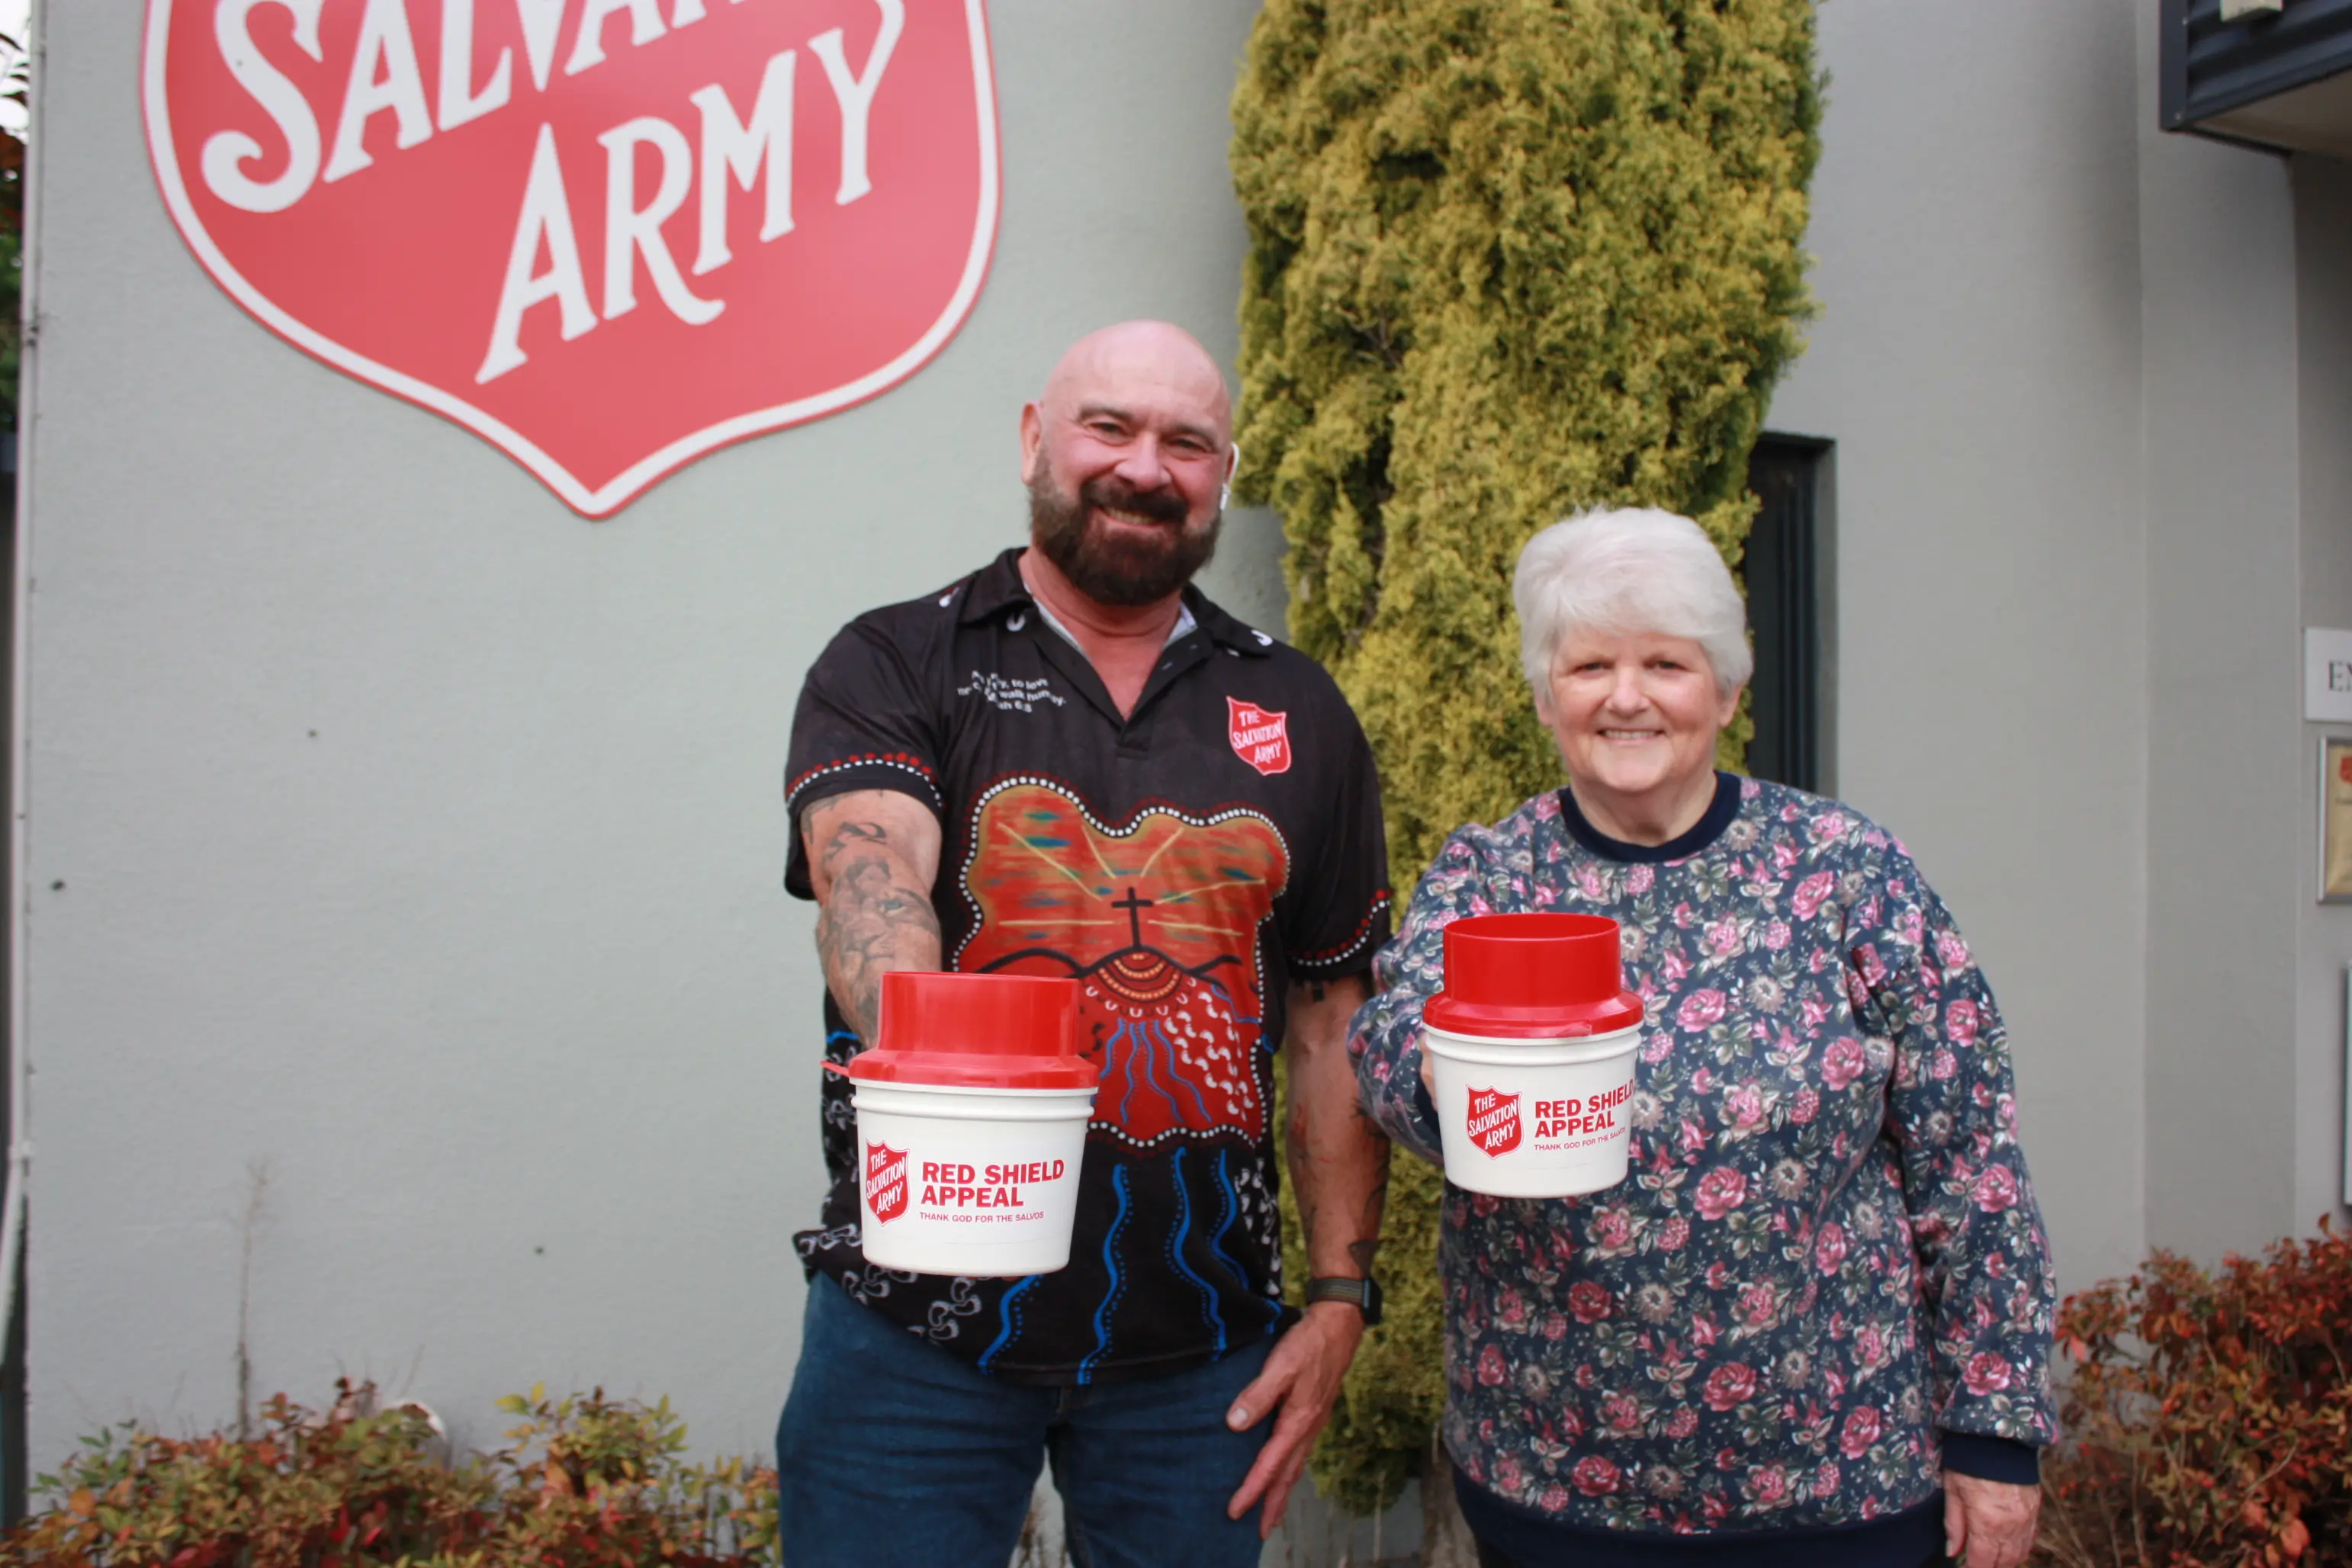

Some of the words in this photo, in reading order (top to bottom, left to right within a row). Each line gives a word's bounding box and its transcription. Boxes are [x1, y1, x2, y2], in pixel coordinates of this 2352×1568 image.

[474, 0, 904, 385] ARMY
[1238, 711, 1260, 727] THE
[1255, 741, 1281, 764] ARMY
[1474, 1093, 1496, 1113] THE
[1535, 1099, 1582, 1118] RED
[1469, 1099, 1518, 1137] SALVATION
[1534, 1110, 1615, 1138] APPEAL
[1485, 1120, 1515, 1150] ARMY
[1563, 1141, 1580, 1149] GOD
[1582, 1139, 1596, 1147] FOR
[1598, 1134, 1609, 1142] THE
[870, 1149, 887, 1172] THE
[922, 1162, 975, 1184] RED
[984, 1159, 1065, 1185] SHIELD
[866, 1156, 905, 1200] SALVATION
[876, 1181, 903, 1214] ARMY
[921, 1185, 1024, 1207] APPEAL
[919, 1212, 949, 1222] THANK
[1016, 1211, 1045, 1222] SALVOS
